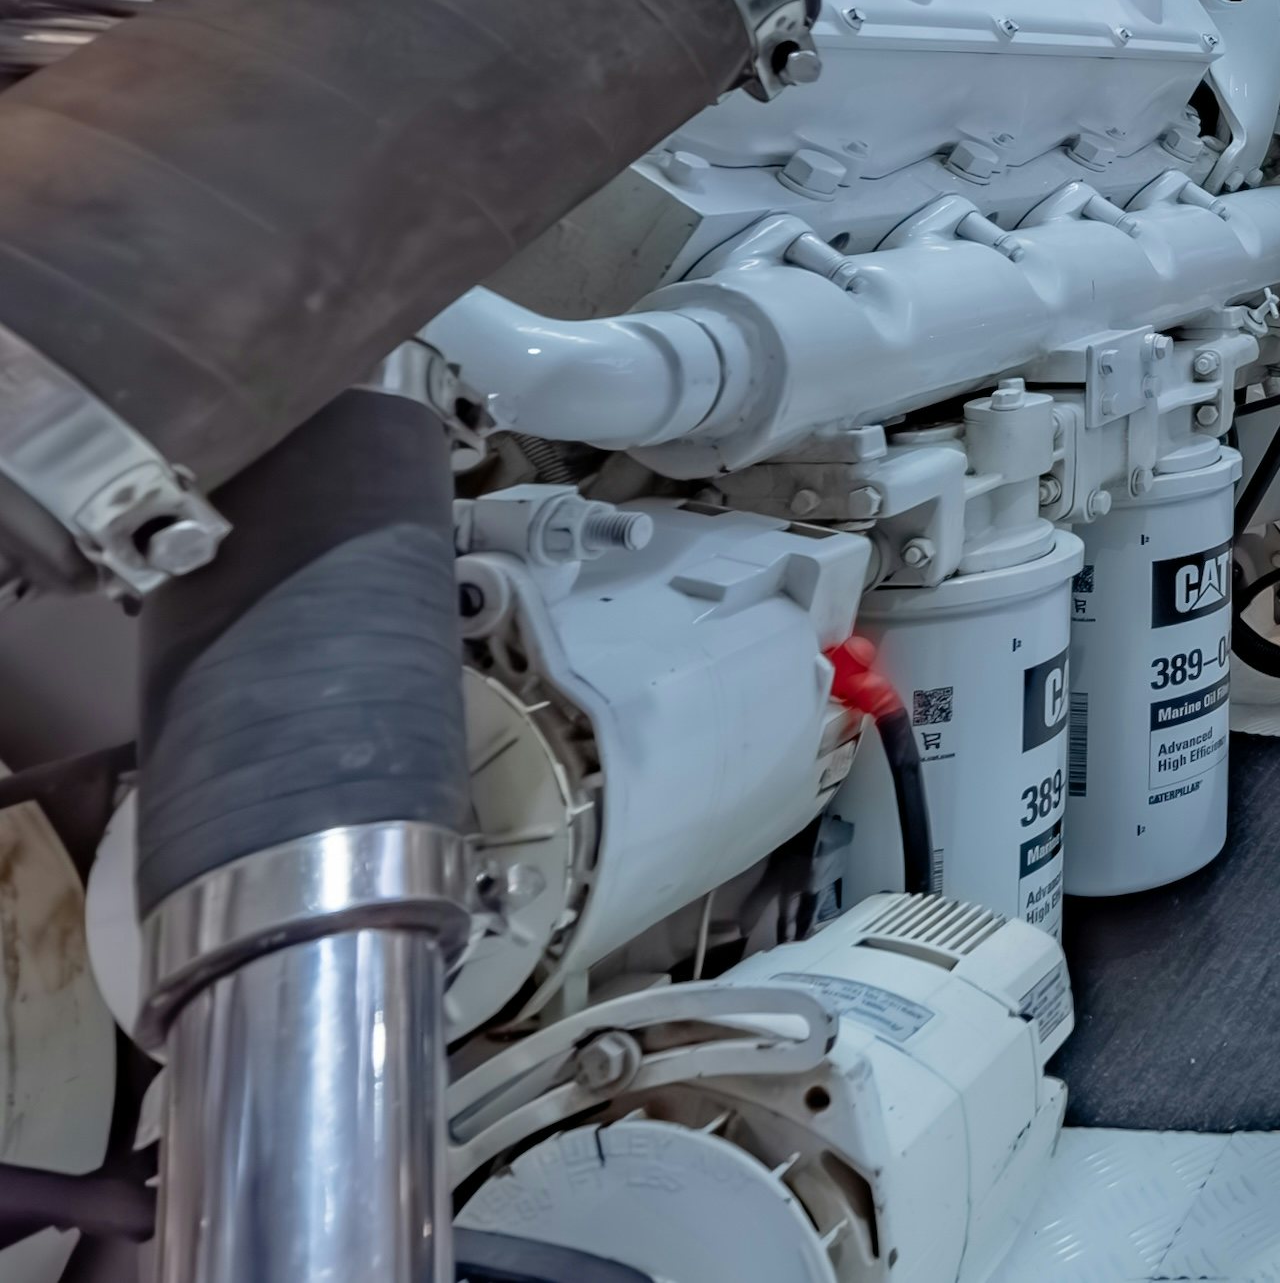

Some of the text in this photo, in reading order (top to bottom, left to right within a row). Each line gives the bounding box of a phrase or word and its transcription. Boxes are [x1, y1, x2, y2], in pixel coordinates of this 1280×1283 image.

[1175, 551, 1230, 613] CAT
[1150, 629, 1231, 690] 389-0
[1158, 701, 1201, 722] Marine
[1203, 692, 1216, 708] Oil
[1158, 726, 1213, 757] Advanced
[1158, 753, 1187, 772] High
[1148, 780, 1201, 805] CATERPILLAR
